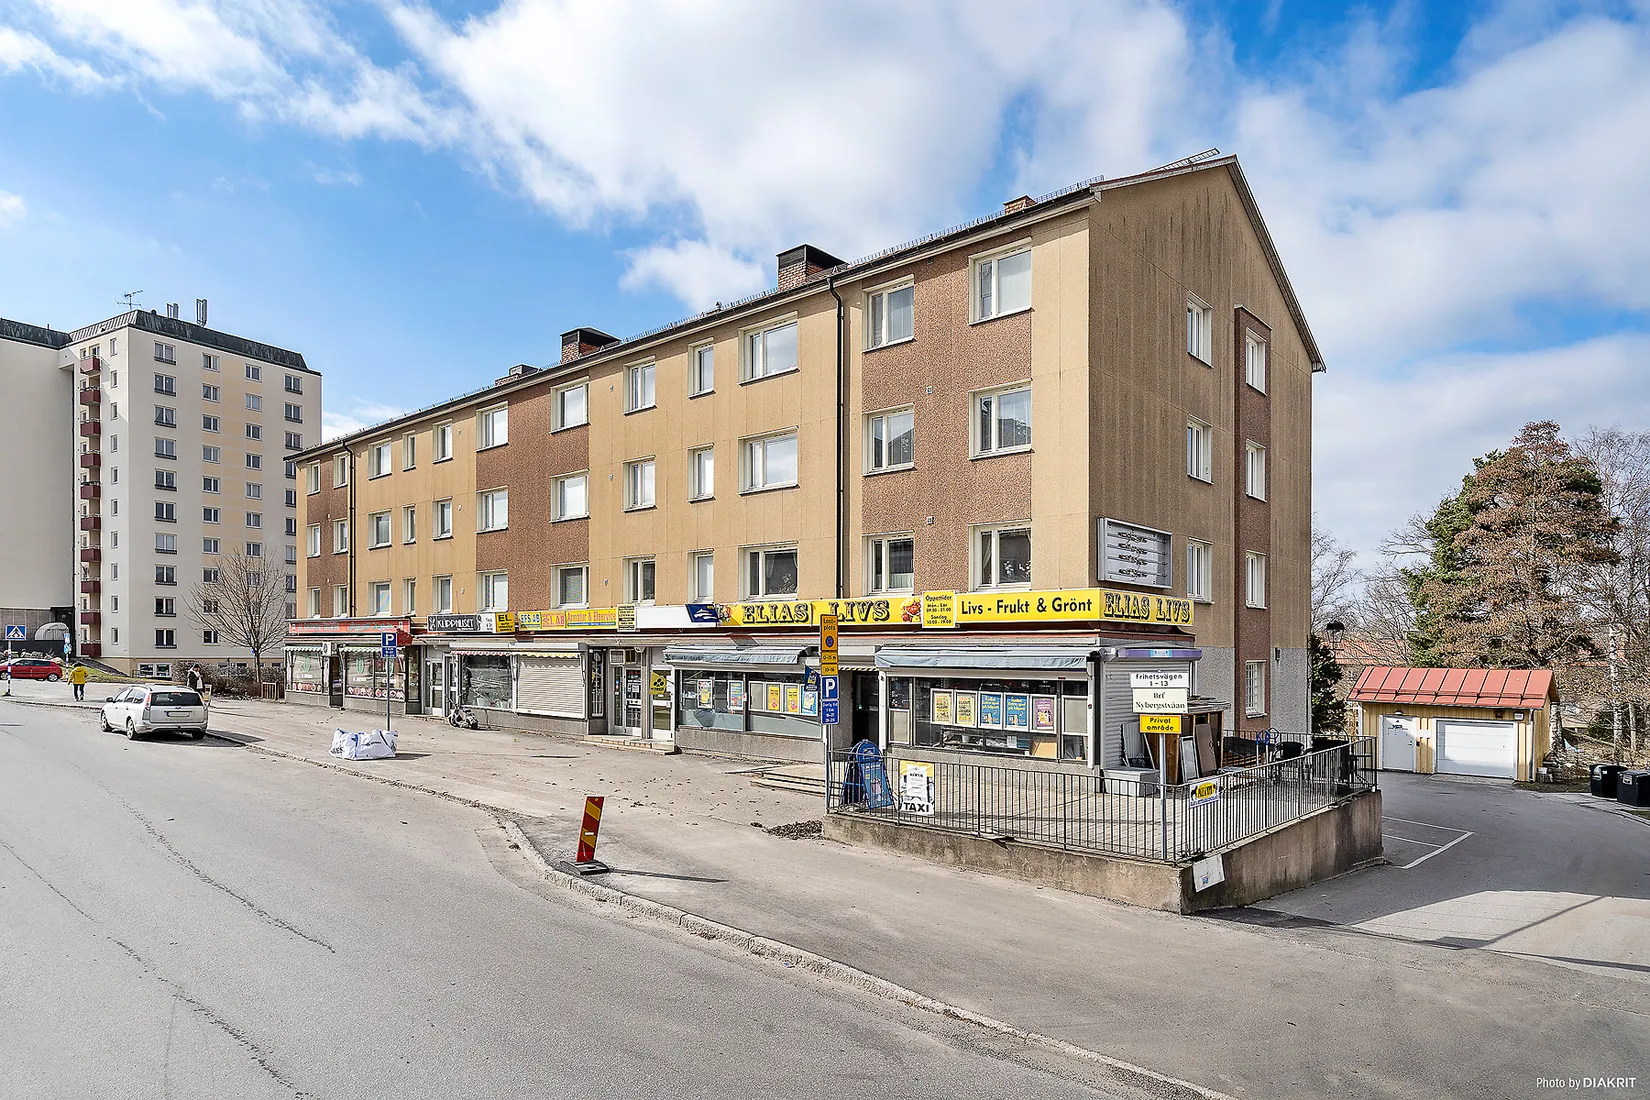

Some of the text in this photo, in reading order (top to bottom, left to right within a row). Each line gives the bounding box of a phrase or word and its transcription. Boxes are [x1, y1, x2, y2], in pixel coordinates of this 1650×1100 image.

[742, 600, 890, 624] ELIAS LIVS
[961, 600, 984, 615] Livs
[996, 599, 1030, 614] Frukt
[1036, 597, 1047, 613] &
[1051, 596, 1093, 613] Grönt
[1104, 591, 1191, 623] ELIAS LIVS
[498, 614, 512, 622] EL
[385, 633, 395, 645] P
[825, 678, 836, 697] P
[903, 801, 930, 813] TAXI
